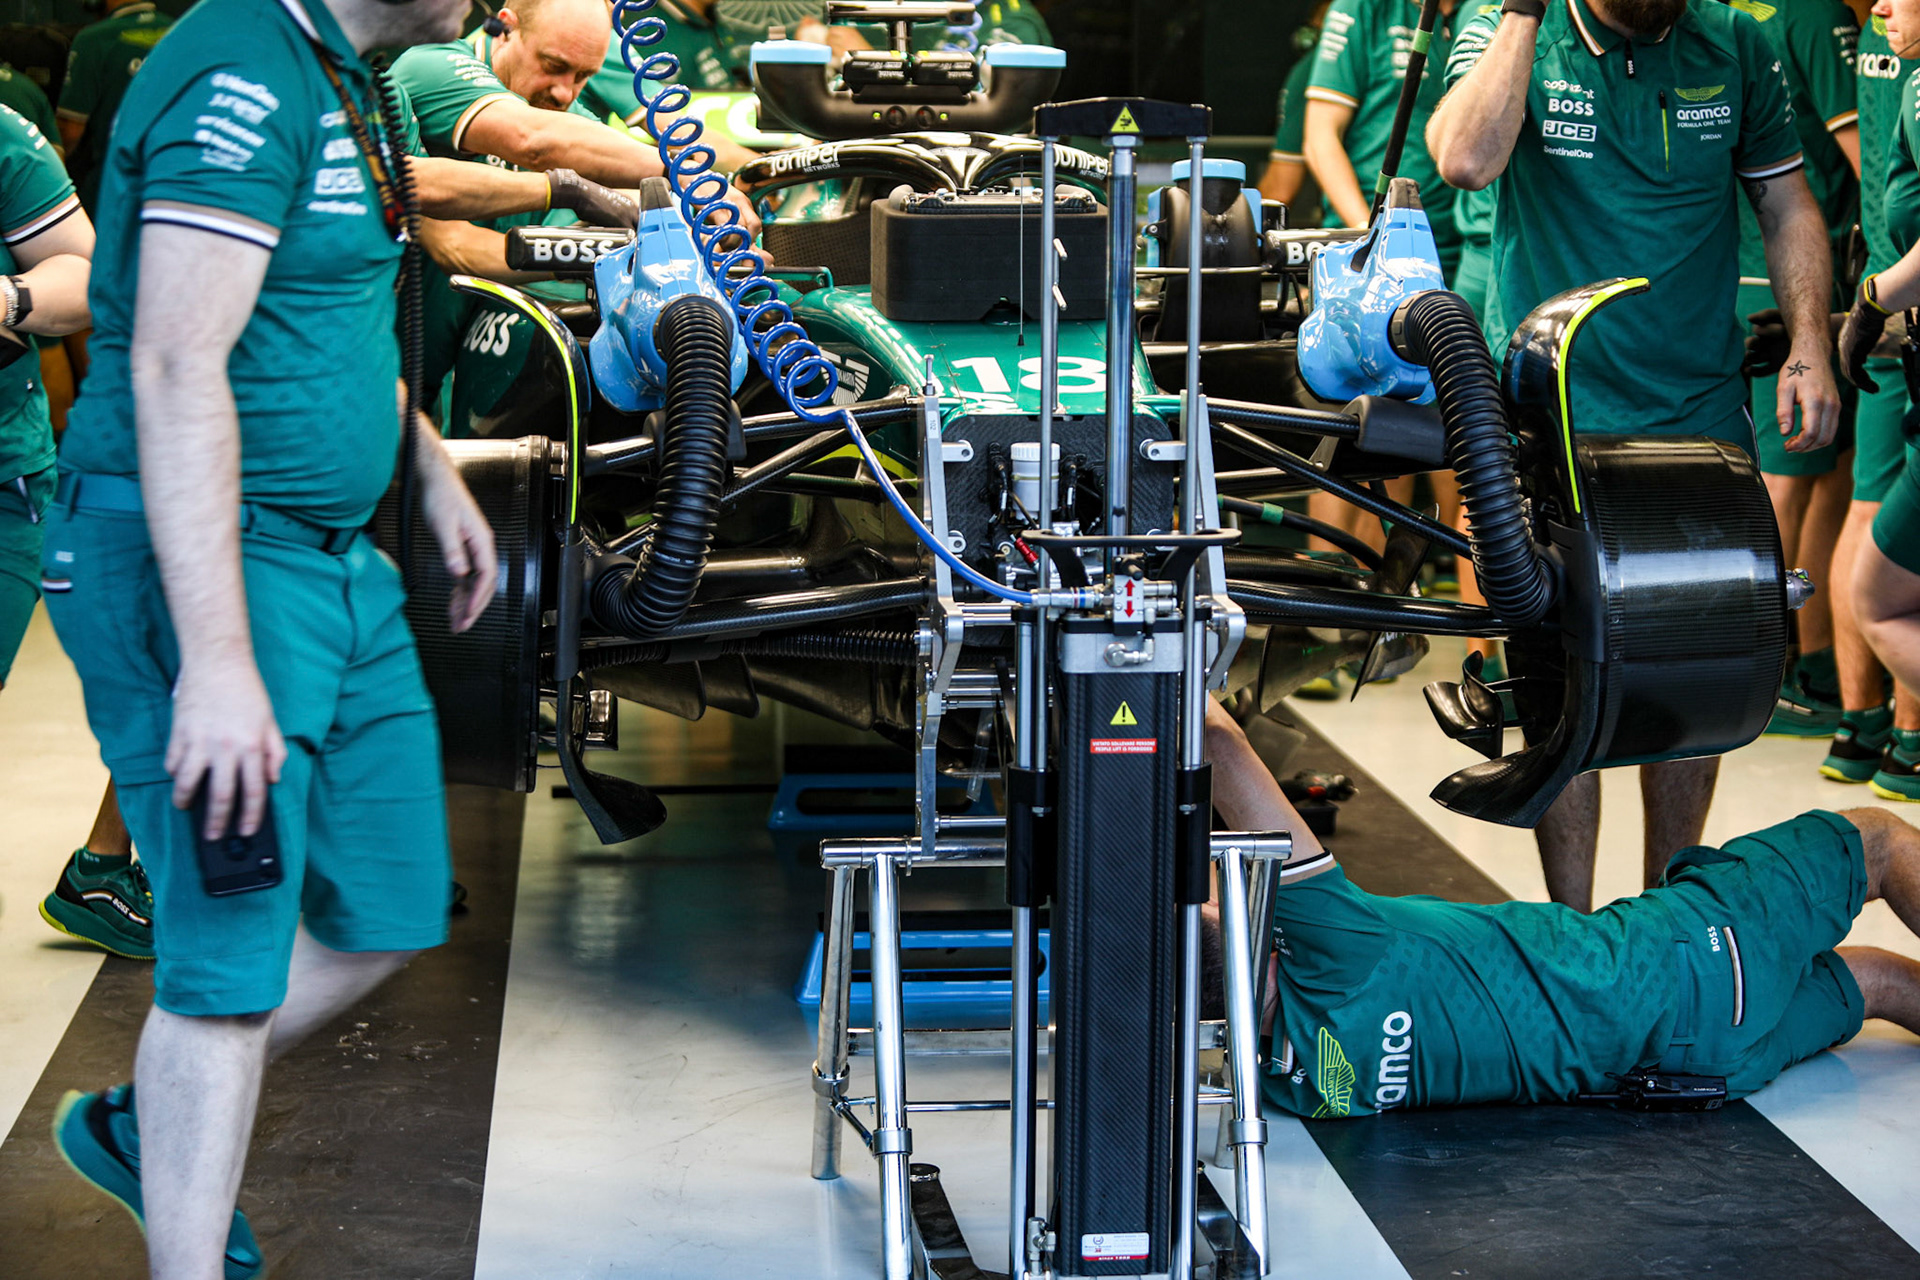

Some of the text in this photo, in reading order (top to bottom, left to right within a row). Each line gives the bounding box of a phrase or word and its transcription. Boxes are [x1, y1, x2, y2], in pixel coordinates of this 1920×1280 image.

[1543, 79, 1595, 99] cogiznt
[1548, 98, 1595, 116] BOSS
[1676, 105, 1731, 121] aramco
[1545, 122, 1595, 140] JCB
[1677, 121, 1703, 129] FORMULA
[1717, 118, 1732, 126] TEAM
[1700, 133, 1722, 141] JORDAN
[1543, 144, 1594, 159] SentinelOne
[769, 145, 843, 177] juniper
[803, 161, 840, 173] NETWORKS
[952, 356, 1107, 394] 18
[112, 898, 130, 915] BOSS
[1707, 926, 1721, 952] BOSS
[1374, 1011, 1413, 1113] ramco
[1291, 1068, 1307, 1085] BO
